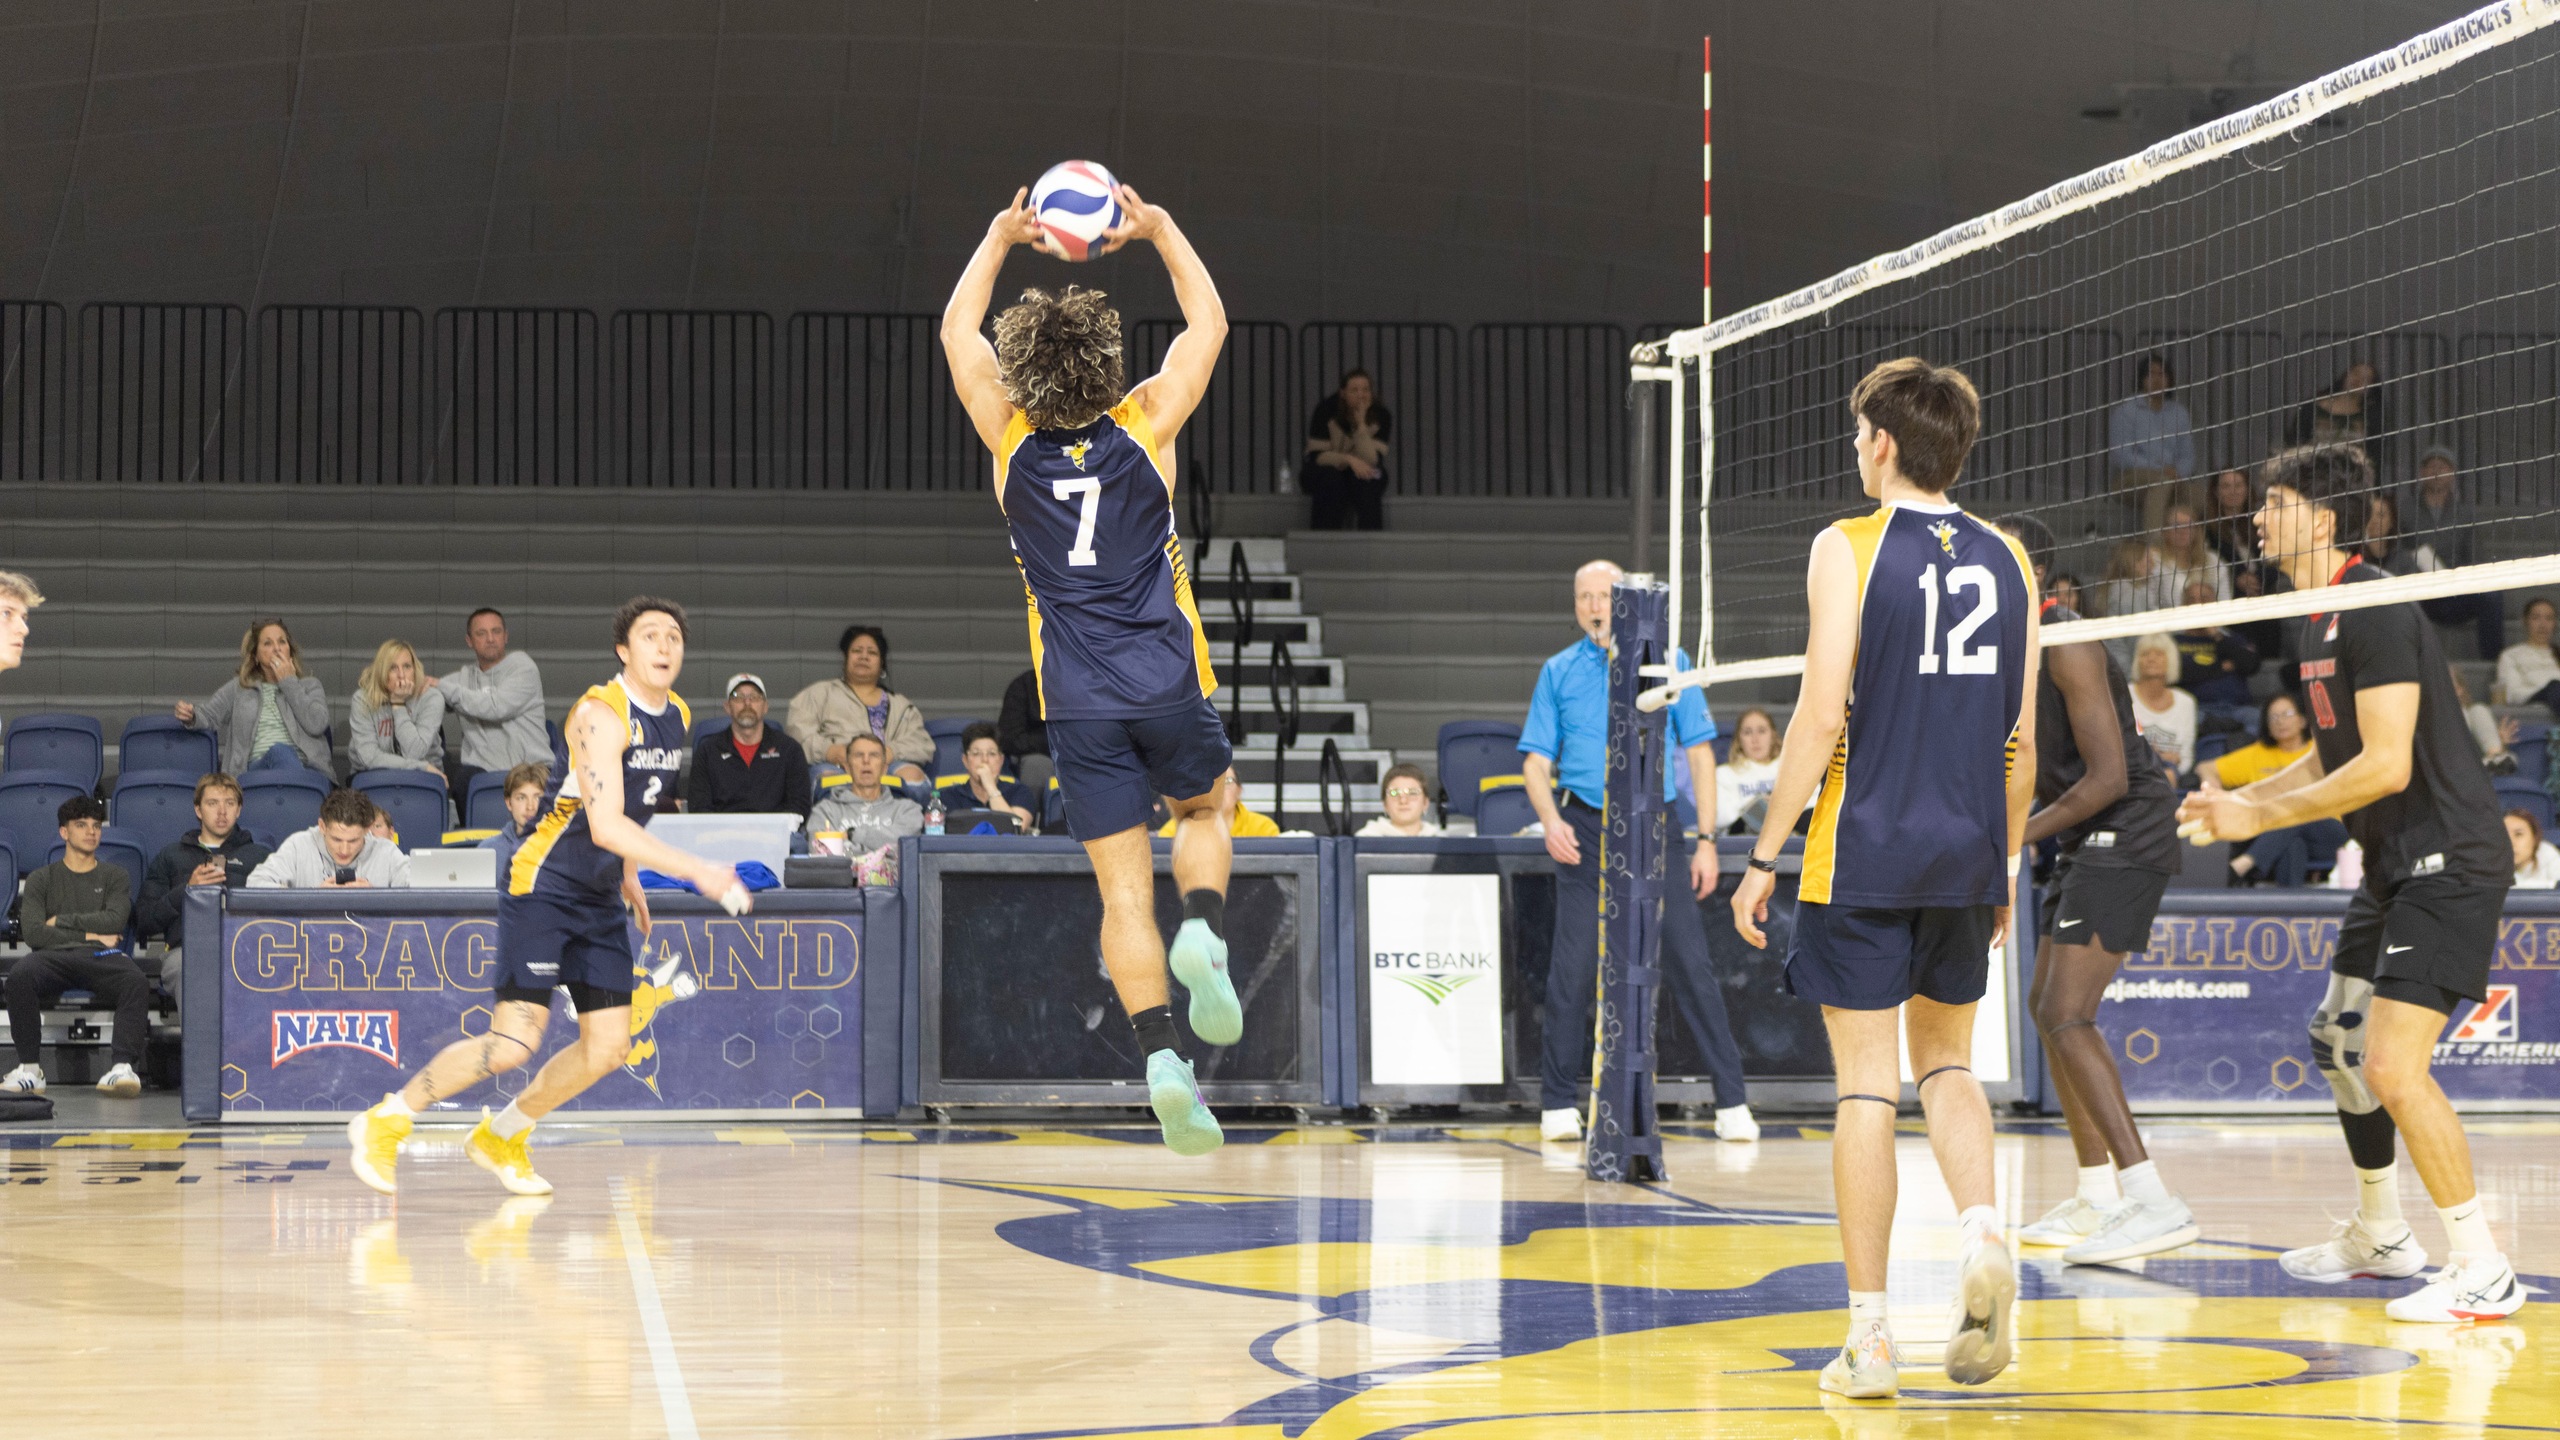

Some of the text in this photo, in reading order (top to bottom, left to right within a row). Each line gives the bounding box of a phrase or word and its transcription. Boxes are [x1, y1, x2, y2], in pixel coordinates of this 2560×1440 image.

[1053, 476, 1101, 567] 7
[1918, 563, 1998, 675] 12
[642, 774, 663, 806] 2
[231, 919, 860, 992] GRACAND
[1374, 952, 1494, 969] BTC BANK
[2101, 978, 2250, 1003] ujackets.com
[274, 1012, 397, 1063] NAIA
[2457, 1043, 2480, 1055] OF
[2481, 1043, 2560, 1058] AMERI
[2472, 1057, 2556, 1066] CONFERENCE
